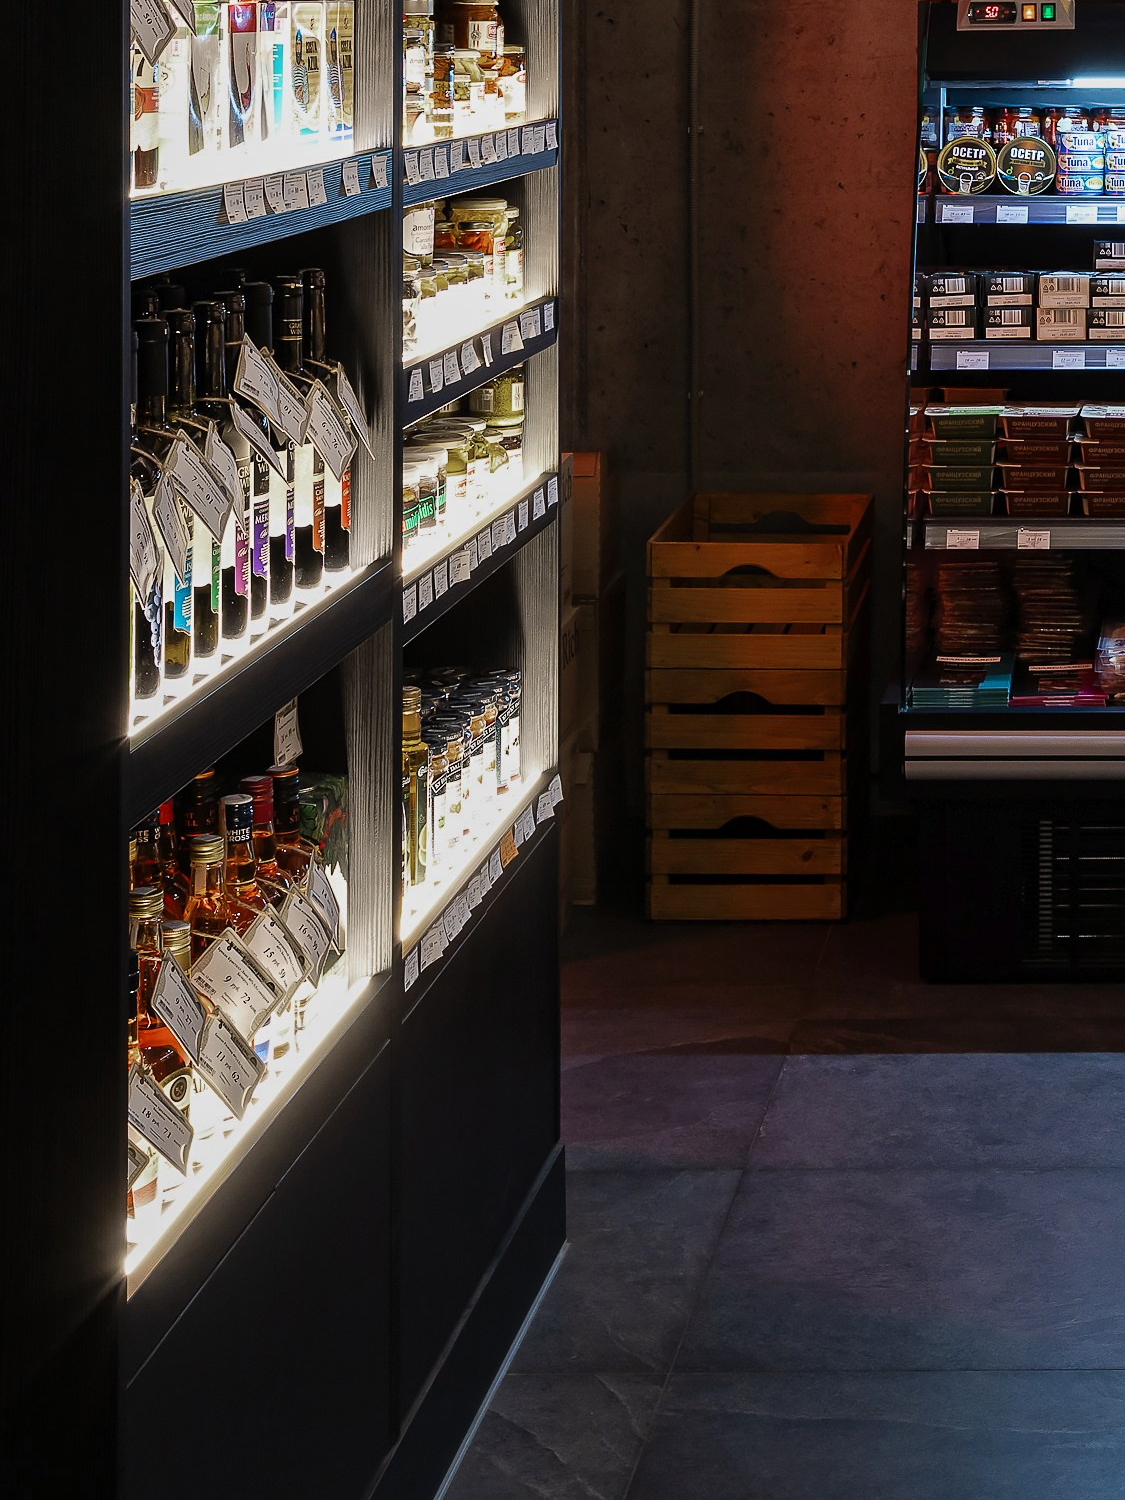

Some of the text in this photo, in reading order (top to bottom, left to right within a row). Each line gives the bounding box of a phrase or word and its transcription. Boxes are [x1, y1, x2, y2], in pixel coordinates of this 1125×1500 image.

[1073, 136, 1094, 146] Tuna
[952, 146, 986, 160] ОСЕТР
[1010, 147, 1044, 160] ОСЕТР
[1066, 157, 1088, 167] Tuna
[1060, 178, 1081, 188] Tuna
[262, 947, 274, 958] 15
[223, 975, 250, 1004] 9 72
[216, 1050, 240, 1082] 11 62
[140, 1106, 172, 1140] 18 71
